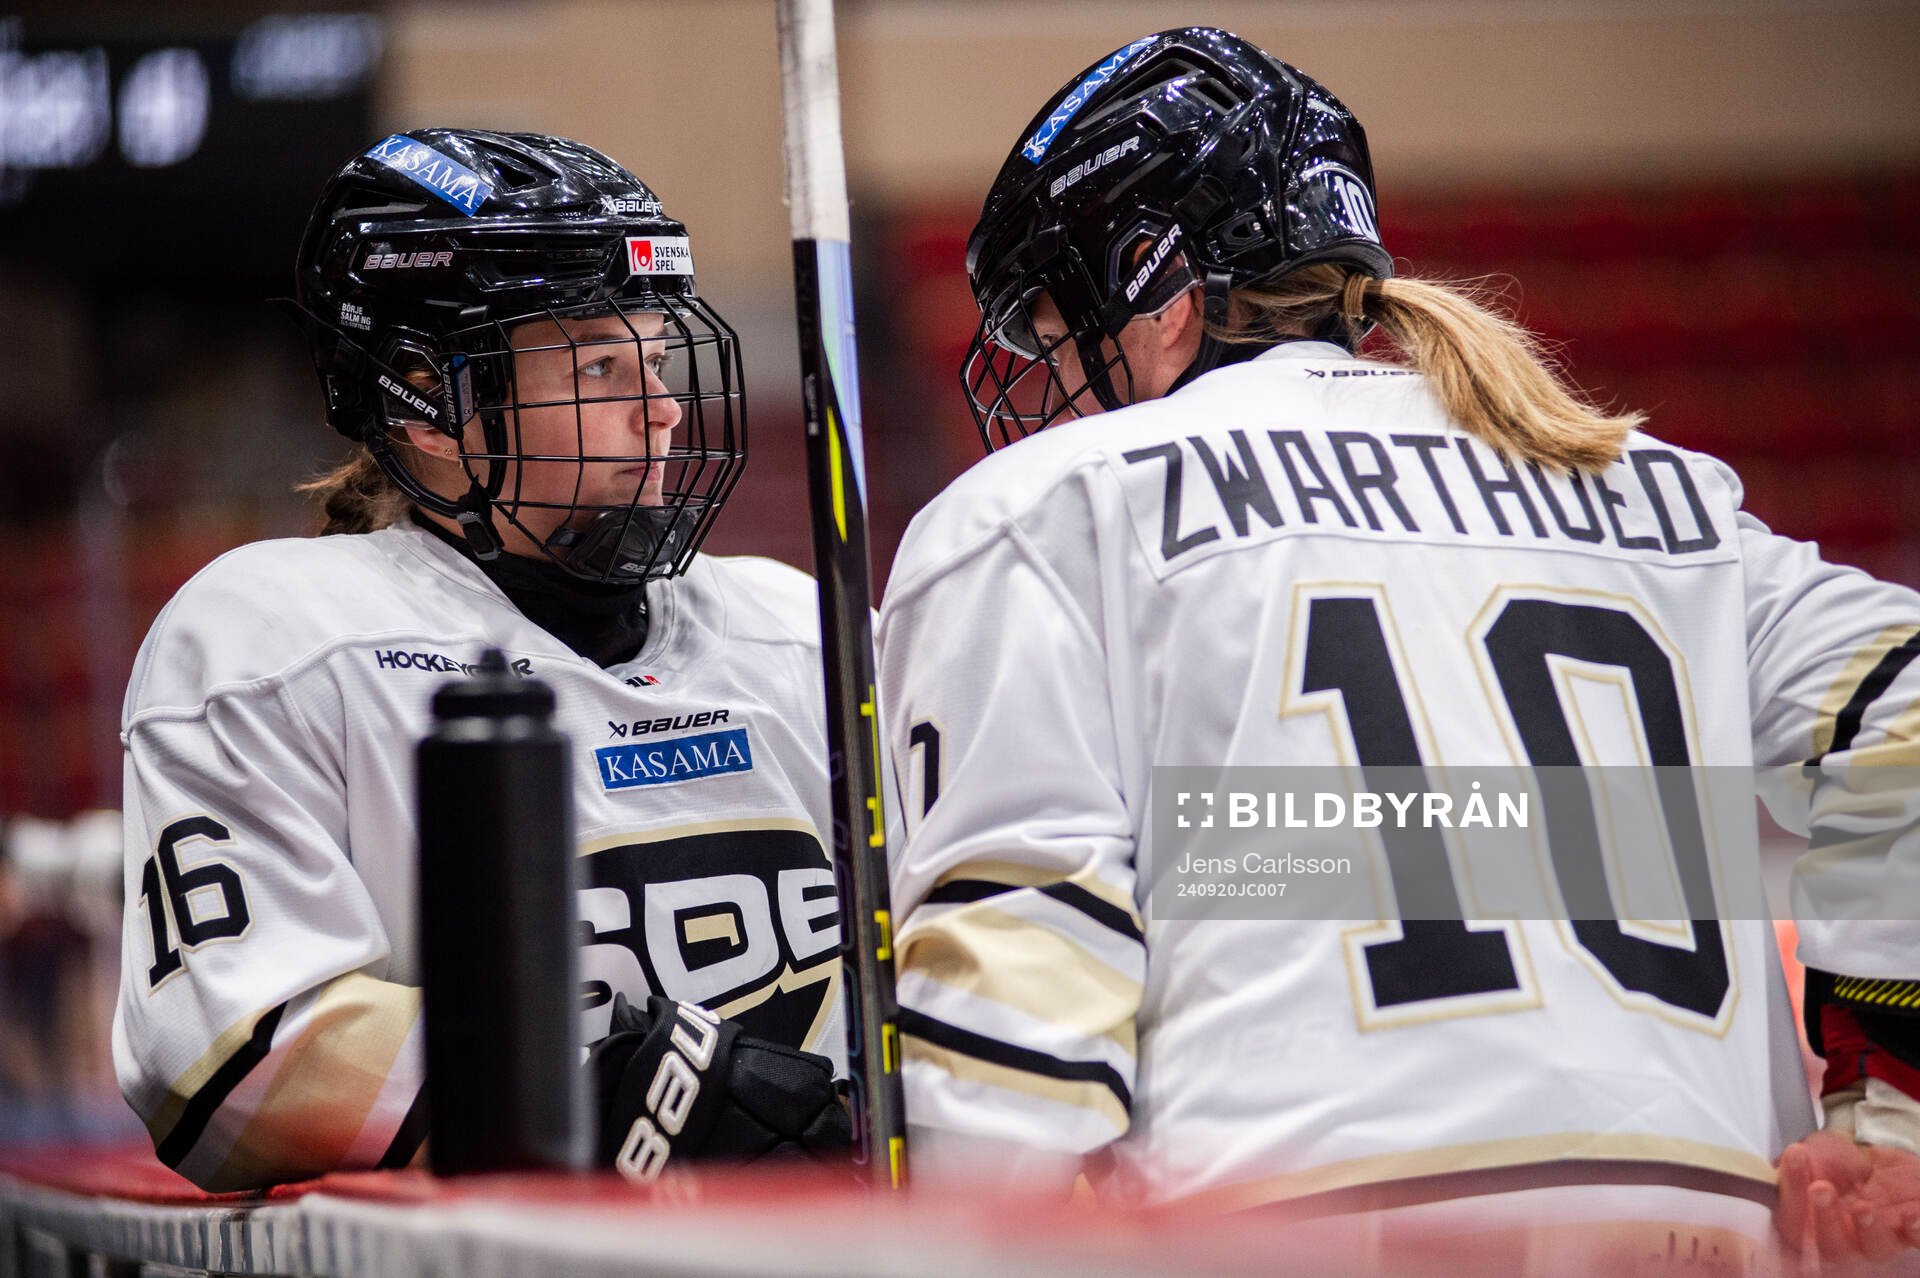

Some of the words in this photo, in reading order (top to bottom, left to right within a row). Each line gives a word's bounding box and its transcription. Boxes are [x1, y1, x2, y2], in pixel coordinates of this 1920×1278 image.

[1024, 41, 1149, 158] KASAMA
[373, 138, 479, 210] KASAMA
[1051, 136, 1140, 198] BAUER
[1334, 175, 1380, 244] 10
[363, 251, 453, 270] BAUER
[654, 246, 690, 258] SVENSKA
[655, 260, 676, 272] SPEL
[1125, 223, 1182, 302] BAUER
[340, 311, 372, 325] SALMNG
[378, 375, 439, 420] BAUER
[443, 373, 457, 424] BAUER
[375, 650, 535, 679] HOCKEYR
[632, 709, 729, 736] BAUER
[604, 739, 747, 782] KASAMA
[1279, 580, 1741, 1038] 10
[139, 813, 255, 997] 16
